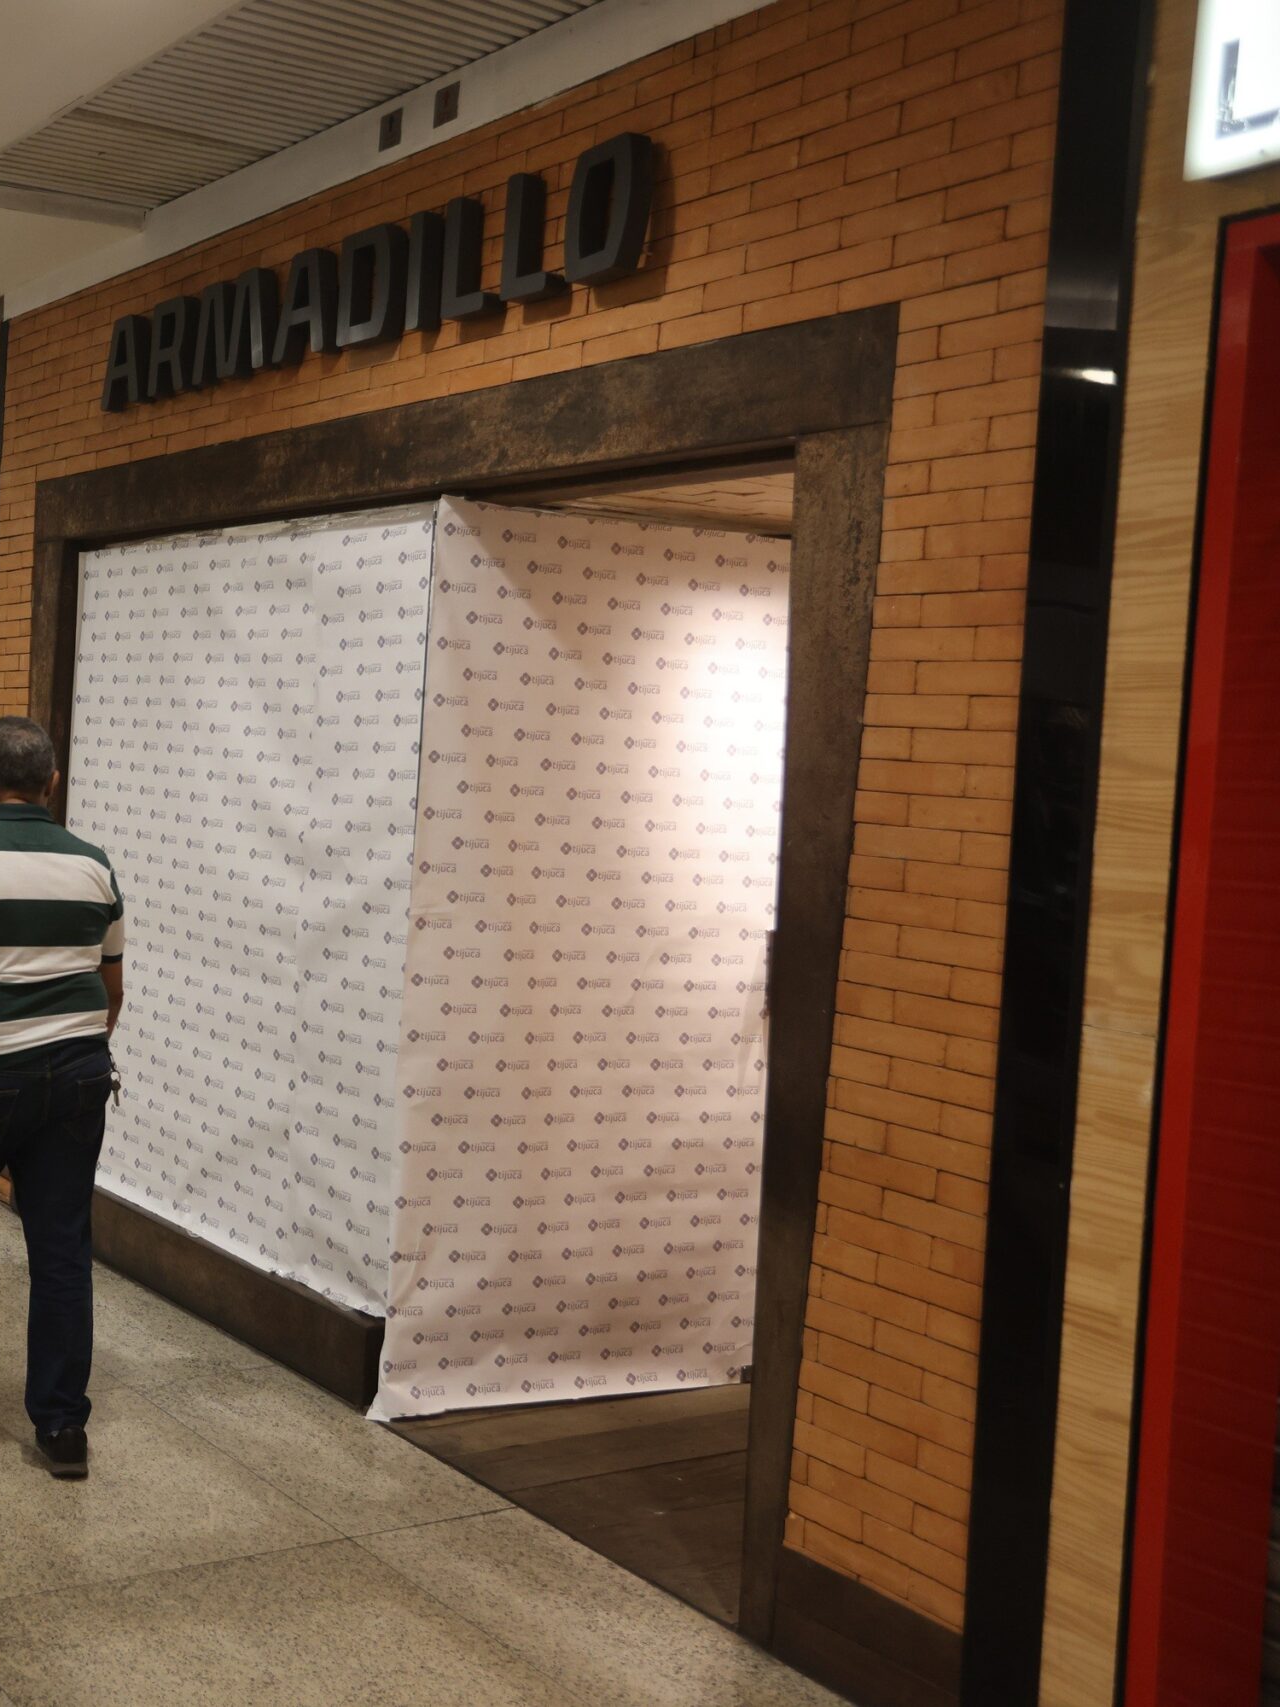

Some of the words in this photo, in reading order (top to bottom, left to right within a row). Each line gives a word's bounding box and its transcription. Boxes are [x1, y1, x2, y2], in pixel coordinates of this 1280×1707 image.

[101, 131, 652, 412] ARMADILLO
[456, 525, 481, 537] tijuca
[513, 532, 537, 544] tijuca
[621, 544, 645, 557] tijuca
[674, 551, 696, 562] tijuca
[482, 557, 506, 569] tijuca
[538, 563, 562, 575] tijuca
[593, 569, 616, 581] tijuca
[698, 582, 720, 592] tijuca
[749, 587, 771, 597] tijuca
[618, 600, 641, 611] tijuca
[478, 613, 503, 625] tijuca
[588, 624, 612, 636] tijuca
[642, 631, 664, 640] tijuca
[448, 639, 471, 651] tijuca
[473, 670, 498, 682] tijuca
[531, 674, 554, 687] tijuca
[446, 695, 469, 707] tijuca
[499, 700, 525, 712] tijuca
[557, 705, 580, 717] tijuca
[610, 709, 632, 720] tijuca
[471, 726, 494, 738] tijuca
[525, 730, 551, 742] tijuca
[582, 734, 604, 746] tijuca
[441, 752, 467, 764] tijuca
[495, 756, 519, 768] tijuca
[606, 765, 629, 775] tijuca
[469, 782, 492, 794] tijuca
[631, 792, 653, 803] tijuca
[436, 808, 462, 821] tijuca
[603, 818, 625, 829] tijuca
[655, 823, 676, 832] tijuca
[517, 840, 540, 853] tijuca
[431, 862, 457, 874] tijuca
[542, 867, 565, 879] tijuca
[597, 870, 621, 882] tijuca
[459, 892, 485, 904] tijuca
[516, 894, 536, 906] tijuca
[622, 899, 645, 910] tijuca
[676, 903, 697, 911] tijuca
[699, 929, 720, 939] tijuca
[455, 947, 481, 960] tijuca
[562, 950, 586, 962] tijuca
[424, 975, 449, 986] tijuca
[452, 1003, 477, 1016] tijuca
[511, 1005, 533, 1017] tijuca
[534, 1032, 555, 1044] tijuca
[636, 1032, 659, 1044] tijuca
[689, 1033, 712, 1044] tijuca
[740, 1033, 761, 1046] tijuca
[660, 1059, 684, 1070] tijuca
[712, 1059, 734, 1070] tijuca
[416, 1086, 442, 1098] tijuca
[475, 1087, 501, 1099] tijuca
[580, 1085, 602, 1097] tijuca
[684, 1086, 707, 1096] tijuca
[443, 1114, 469, 1126] tijuca
[502, 1115, 526, 1127] tijuca
[553, 1113, 575, 1125] tijuca
[604, 1112, 627, 1124] tijuca
[412, 1141, 436, 1154] tijuca
[470, 1142, 496, 1154] tijuca
[528, 1141, 549, 1153] tijuca
[577, 1139, 599, 1151] tijuca
[629, 1138, 652, 1150] tijuca
[733, 1138, 755, 1149] tijuca
[437, 1168, 463, 1181] tijuca
[497, 1169, 522, 1181] tijuca
[550, 1167, 572, 1179] tijuca
[601, 1165, 624, 1178] tijuca
[654, 1164, 676, 1176] tijuca
[625, 1191, 648, 1203] tijuca
[676, 1188, 699, 1201] tijuca
[727, 1188, 749, 1200] tijuca
[408, 1196, 431, 1209] tijuca
[465, 1196, 491, 1208] tijuca
[524, 1195, 546, 1208] tijuca
[598, 1218, 621, 1230] tijuca
[699, 1214, 722, 1227] tijuca
[433, 1223, 458, 1235] tijuca
[493, 1223, 518, 1236] tijuca
[547, 1221, 570, 1233] tijuca
[622, 1244, 645, 1257] tijuca
[674, 1242, 696, 1256] tijuca
[722, 1239, 744, 1251] tijuca
[460, 1250, 486, 1263] tijuca
[519, 1249, 542, 1262] tijuca
[646, 1269, 668, 1281] tijuca
[695, 1265, 717, 1278] tijuca
[488, 1277, 512, 1290] tijuca
[543, 1275, 566, 1287] tijuca
[596, 1272, 618, 1284] tijuca
[566, 1299, 589, 1311] tijuca
[618, 1296, 640, 1309] tijuca
[668, 1293, 690, 1305] tijuca
[457, 1304, 481, 1317] tijuca
[513, 1302, 536, 1315] tijuca
[588, 1323, 612, 1336] tijuca
[639, 1319, 662, 1332] tijuca
[424, 1332, 449, 1344] tijuca
[481, 1329, 505, 1341] tijuca
[535, 1326, 560, 1338] tijuca
[558, 1350, 582, 1362] tijuca
[610, 1347, 633, 1359] tijuca
[661, 1344, 684, 1356] tijuca
[449, 1356, 475, 1369] tijuca
[505, 1353, 528, 1366] tijuca
[393, 1359, 417, 1373] tijuca
[636, 1372, 658, 1384] tijuca
[686, 1368, 709, 1380] tijuca
[421, 1385, 445, 1398] tijuca
[477, 1382, 503, 1396] tijuca
[531, 1379, 555, 1392] tijuca
